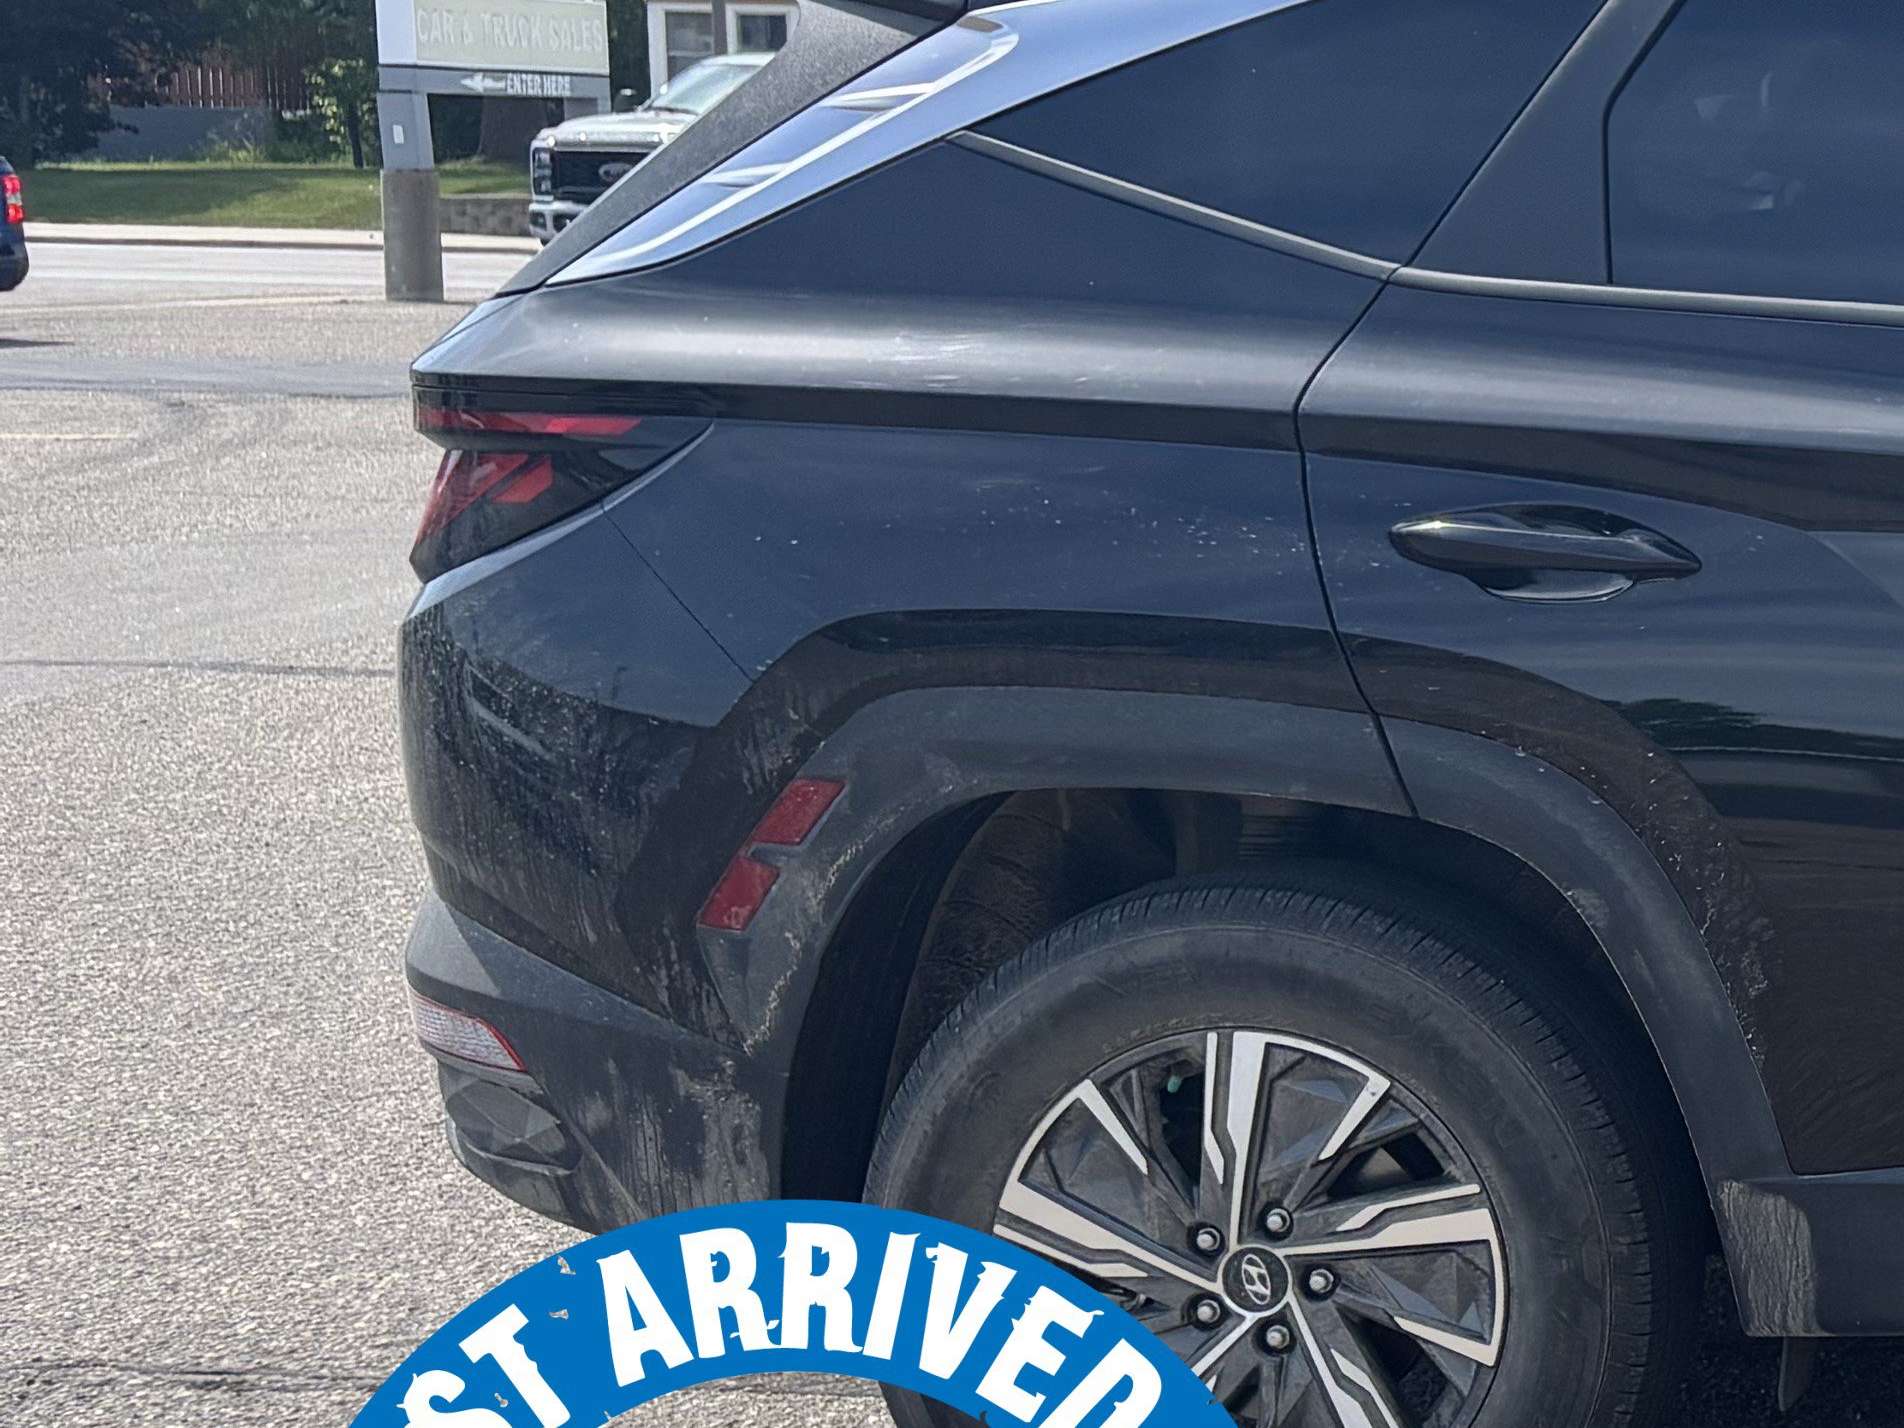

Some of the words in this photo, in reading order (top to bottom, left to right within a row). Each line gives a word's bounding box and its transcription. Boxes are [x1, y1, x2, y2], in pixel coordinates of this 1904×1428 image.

[417, 8, 454, 45] CAR
[480, 12, 543, 49] TRUCK
[548, 18, 603, 53] SALES
[506, 73, 542, 95] ENTER
[543, 75, 572, 97] HERE
